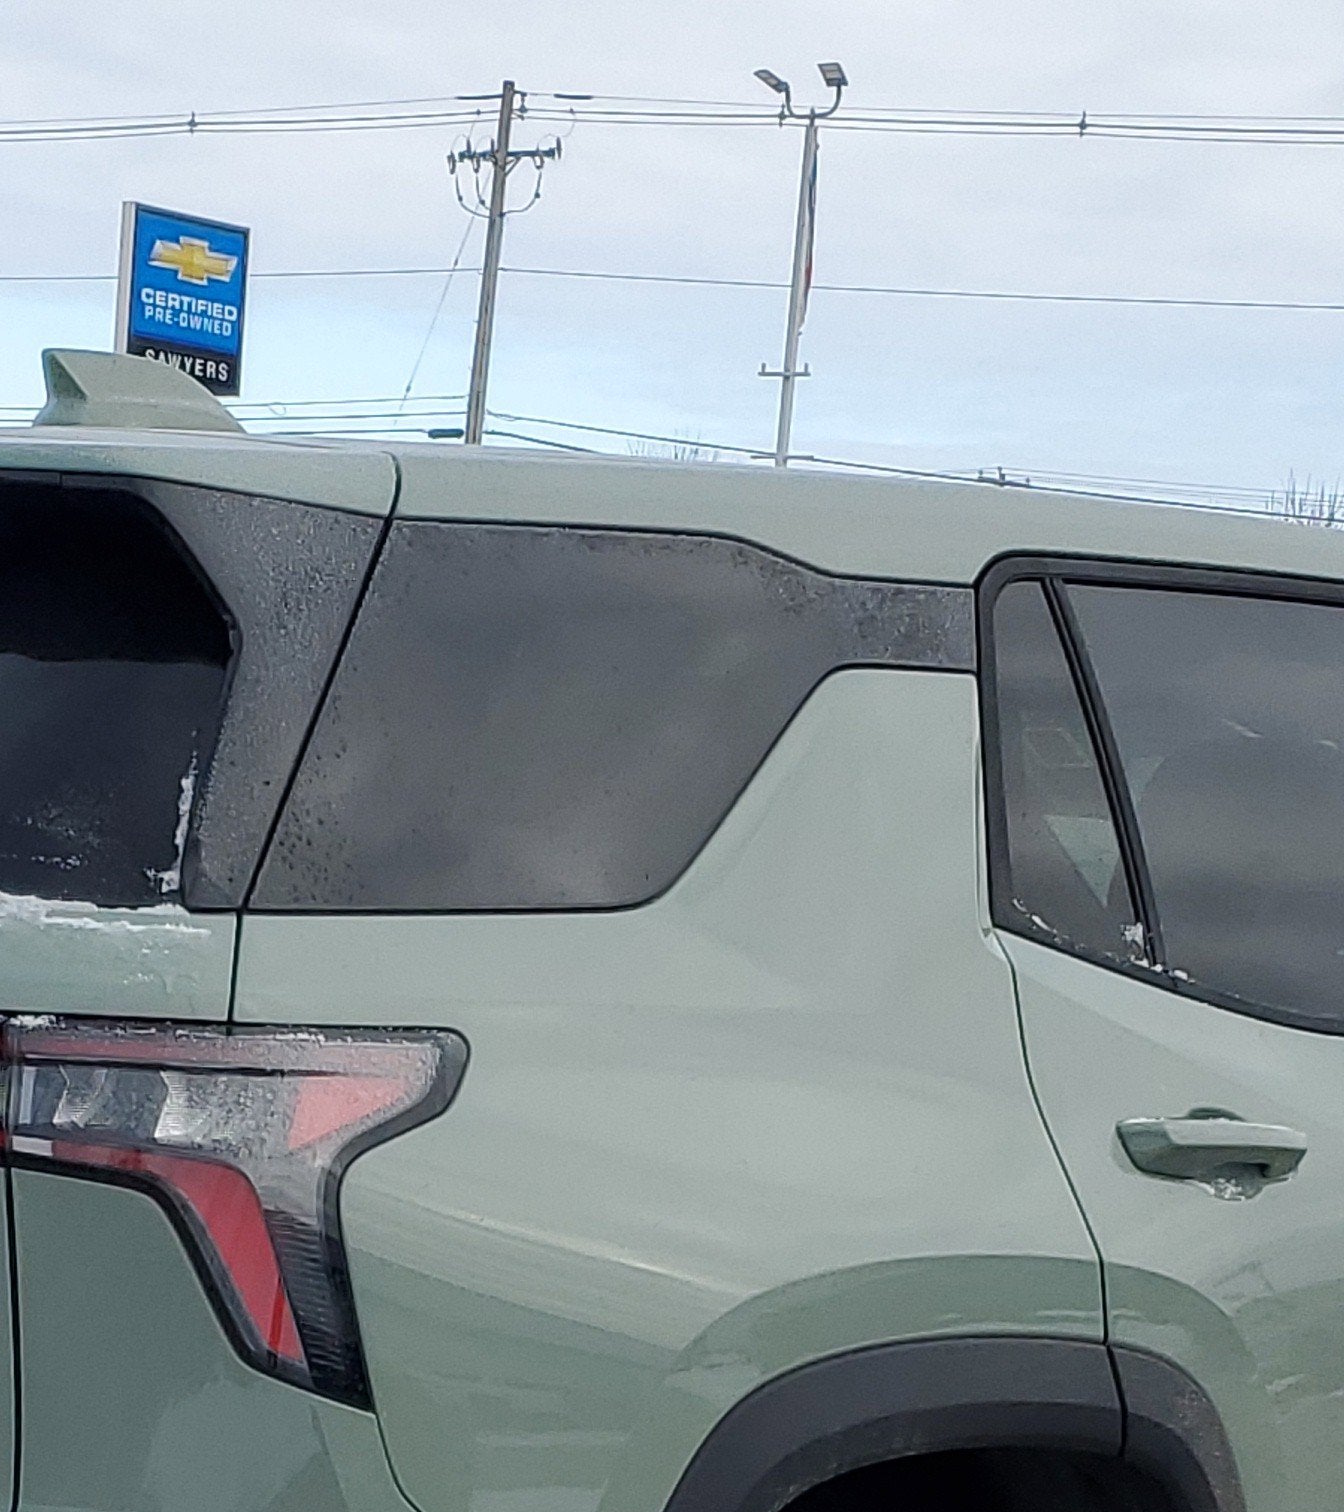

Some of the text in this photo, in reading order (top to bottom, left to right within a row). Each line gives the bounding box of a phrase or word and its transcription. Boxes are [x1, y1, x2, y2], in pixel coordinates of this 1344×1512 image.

[141, 288, 237, 322] CERTIFIED
[145, 305, 232, 336] PRE-OWNED
[144, 349, 229, 381] SAWYERS
